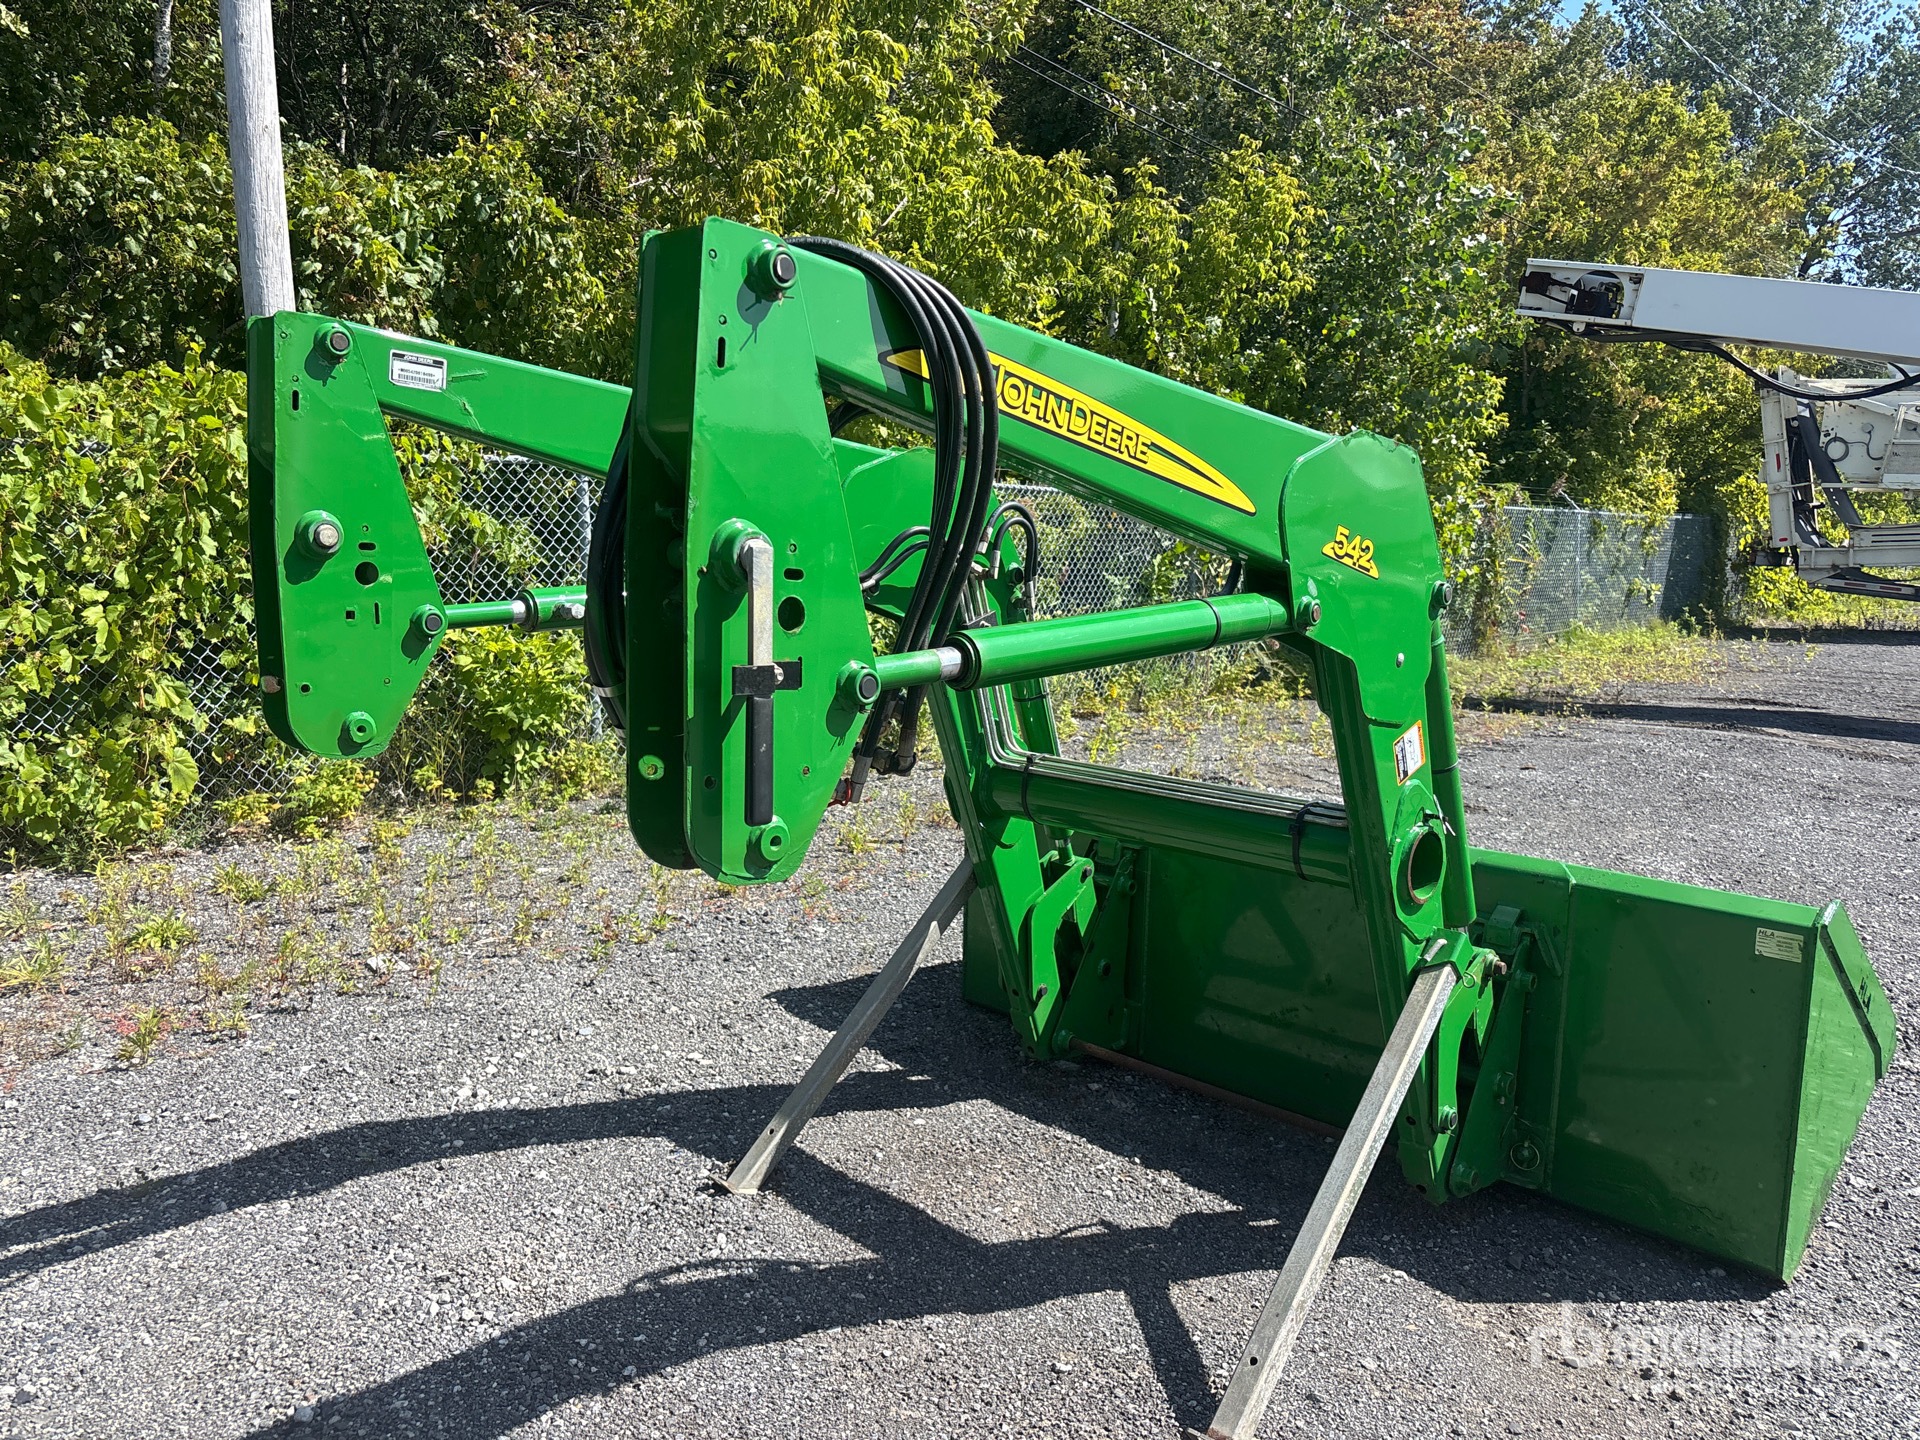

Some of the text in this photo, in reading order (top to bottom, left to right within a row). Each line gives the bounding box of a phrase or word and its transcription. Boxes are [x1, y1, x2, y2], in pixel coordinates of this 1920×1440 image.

[417, 356, 434, 365] DEERE
[996, 364, 1151, 464] JOHN DEERE
[1334, 524, 1374, 573] 542
[1758, 929, 1775, 938] HLA
